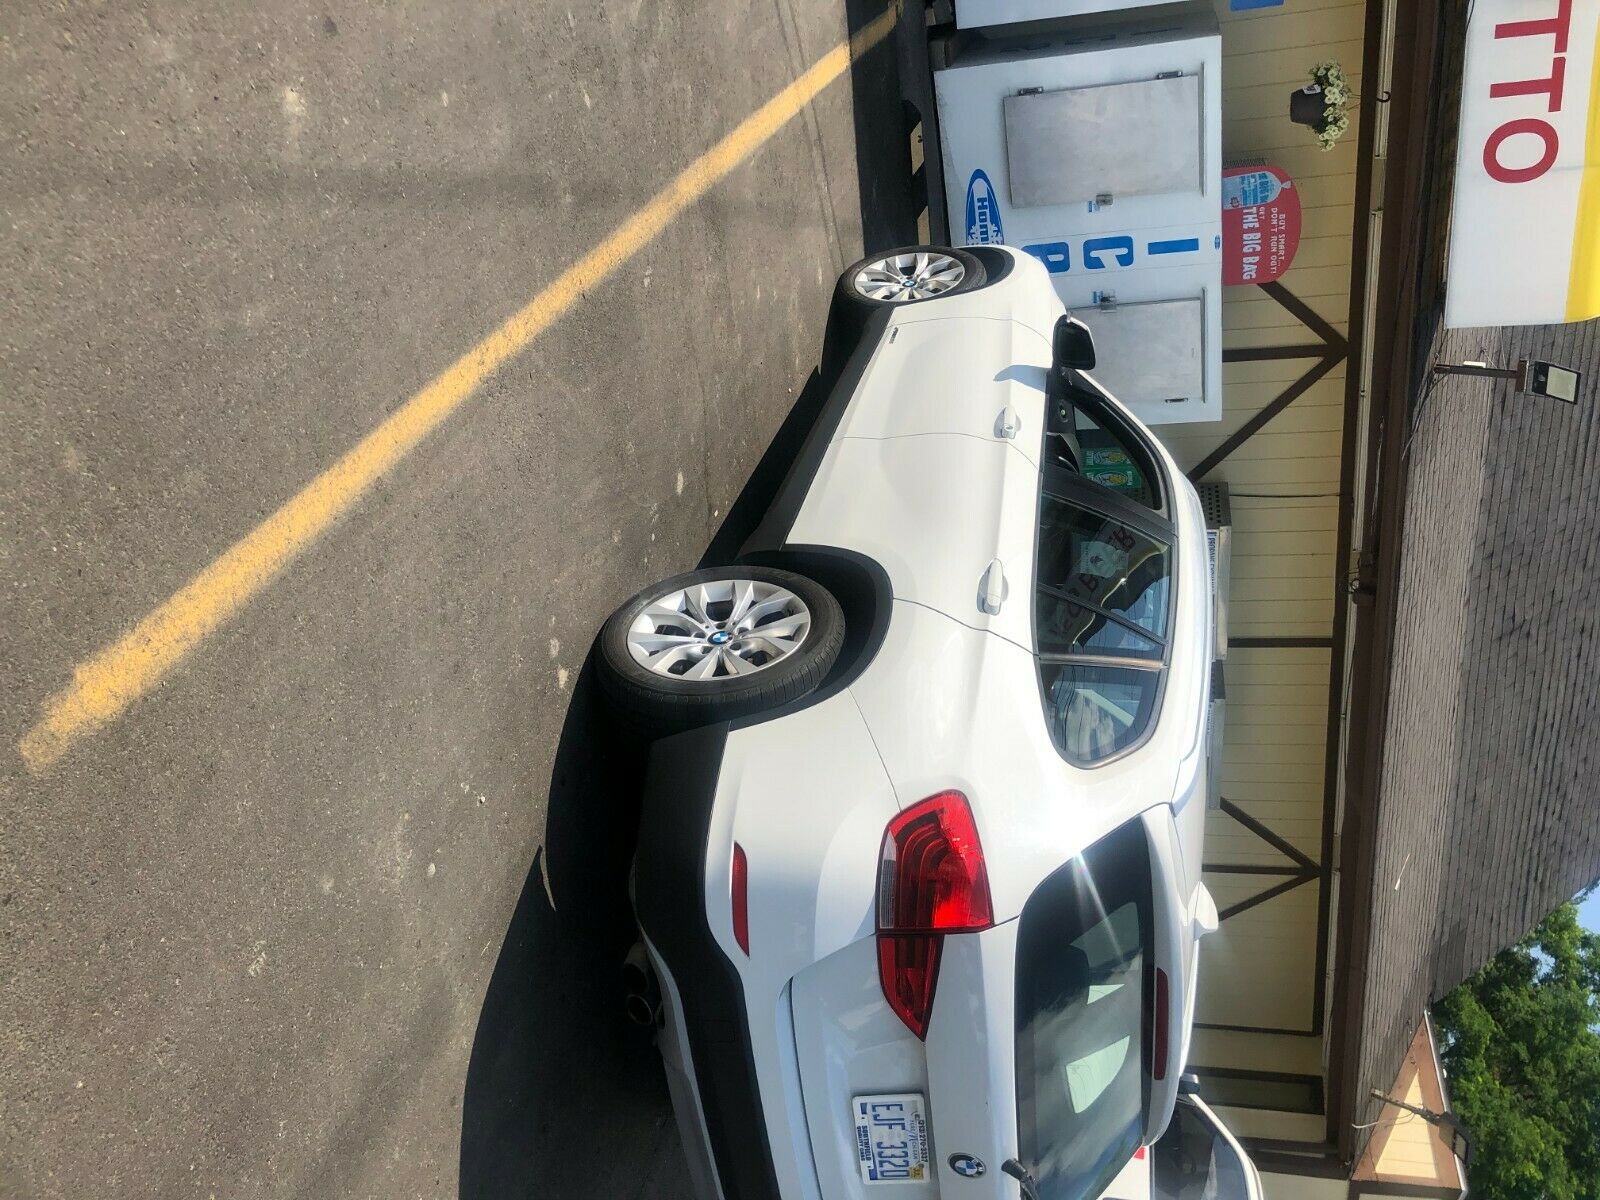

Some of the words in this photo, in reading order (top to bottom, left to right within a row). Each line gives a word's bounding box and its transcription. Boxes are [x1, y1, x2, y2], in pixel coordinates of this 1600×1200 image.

[1484, 0, 1572, 183] TTO
[975, 197, 991, 245] Hom
[1242, 206, 1260, 229] THE
[1270, 207, 1278, 233] DON'T
[1278, 214, 1286, 230] BUY
[1242, 232, 1261, 252] BIG
[1270, 236, 1278, 253] RUN
[1242, 256, 1259, 280] BAG
[872, 1103, 906, 1130] EJF
[862, 1125, 872, 1161] SOUTHFIELD
[877, 1141, 909, 1177] 3320
